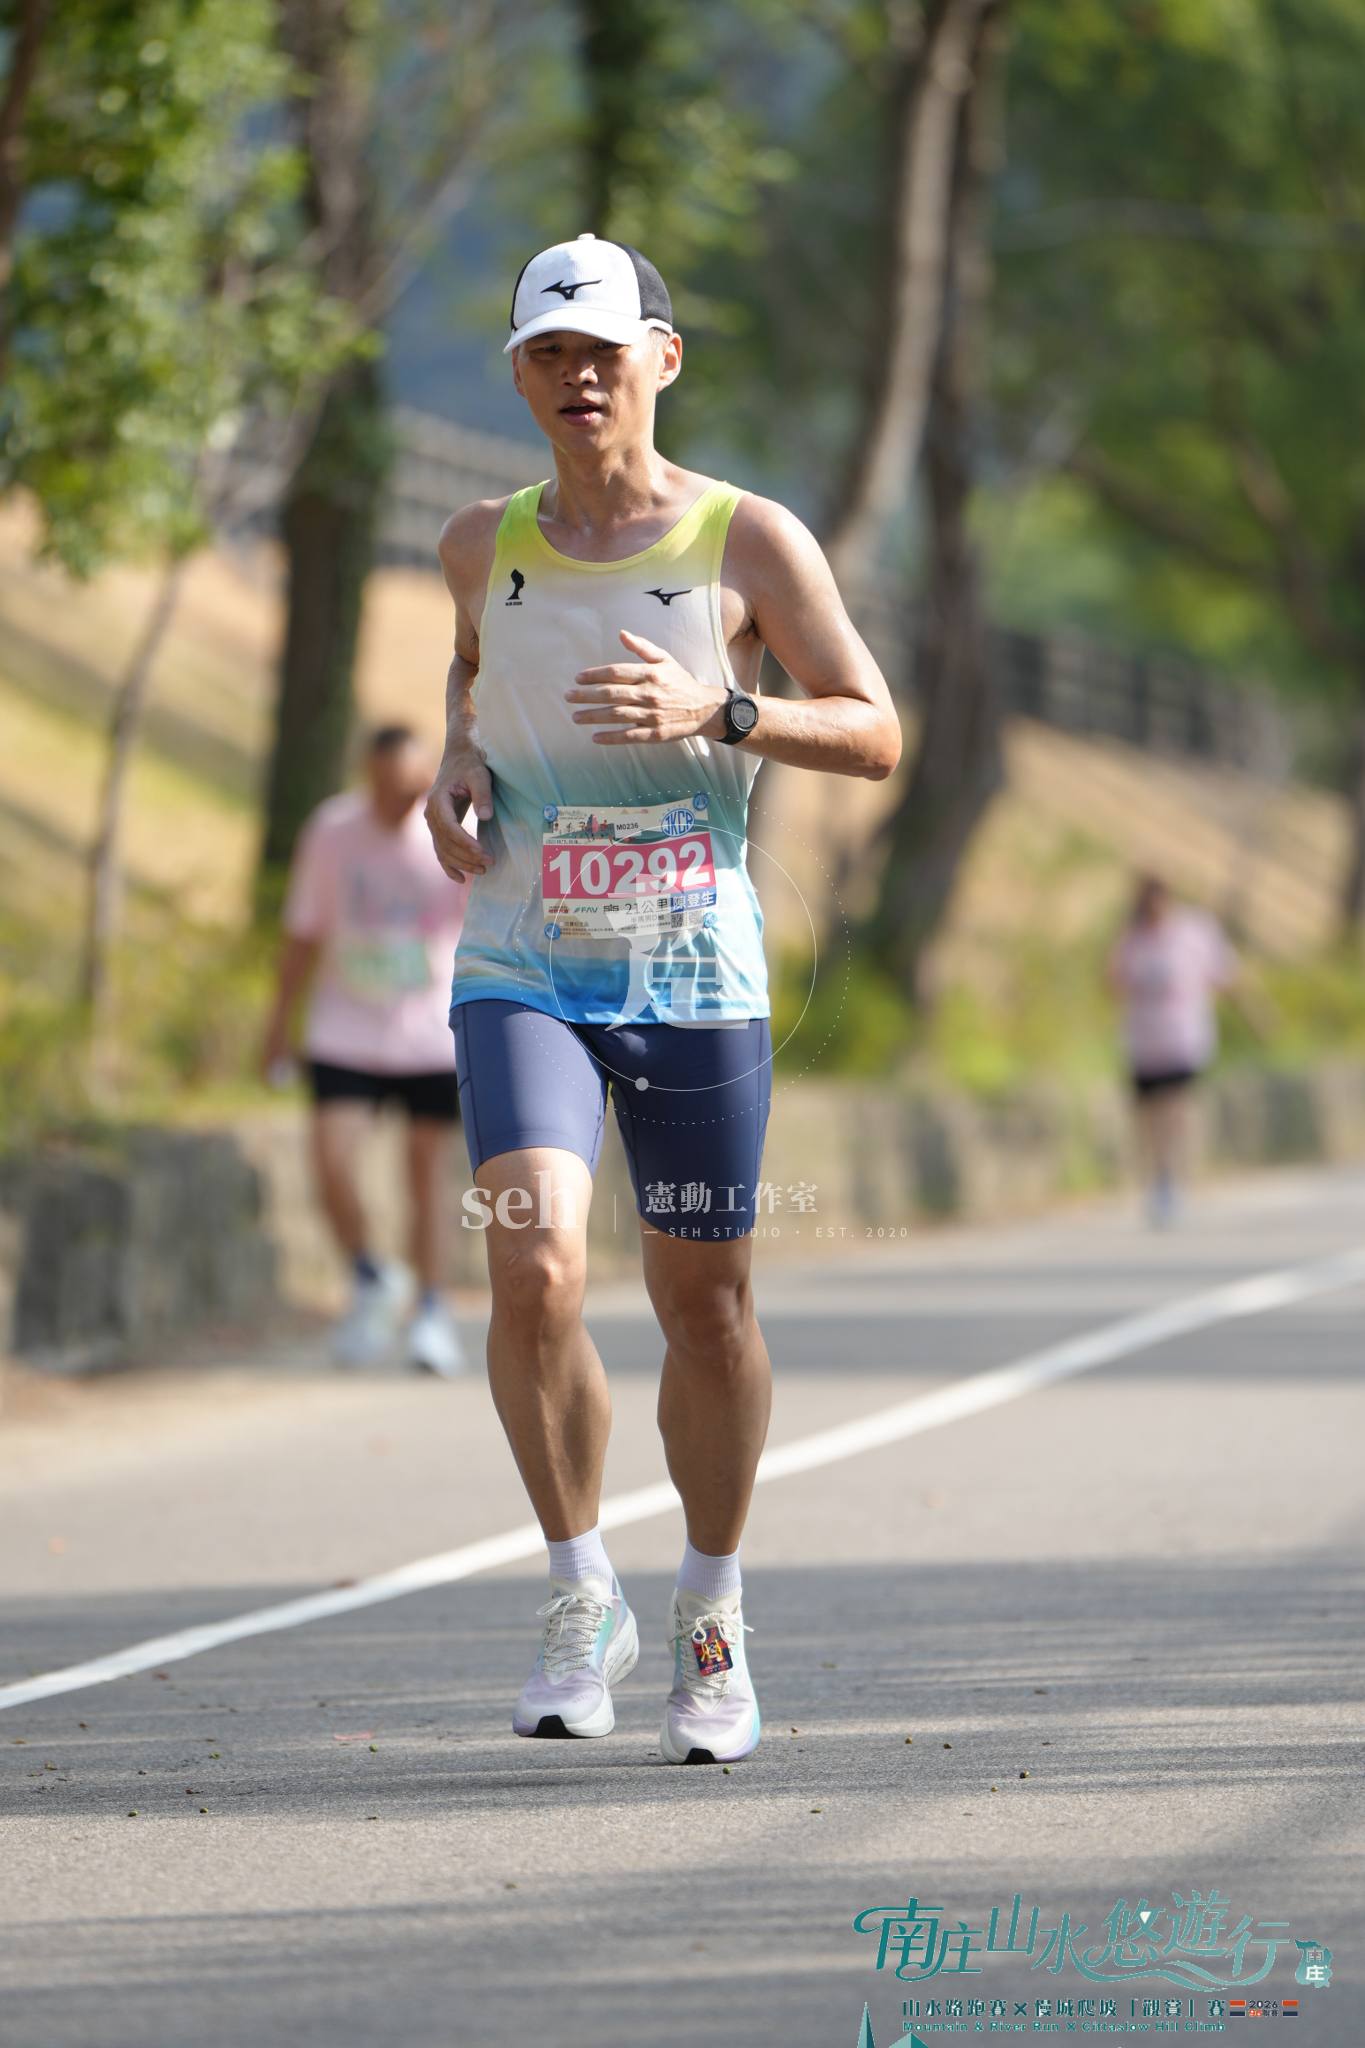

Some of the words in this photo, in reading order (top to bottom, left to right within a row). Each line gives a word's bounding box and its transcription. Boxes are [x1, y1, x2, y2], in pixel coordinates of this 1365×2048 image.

[616, 822, 639, 831] M0236
[664, 809, 694, 836] JKCR
[549, 841, 711, 896] 10292
